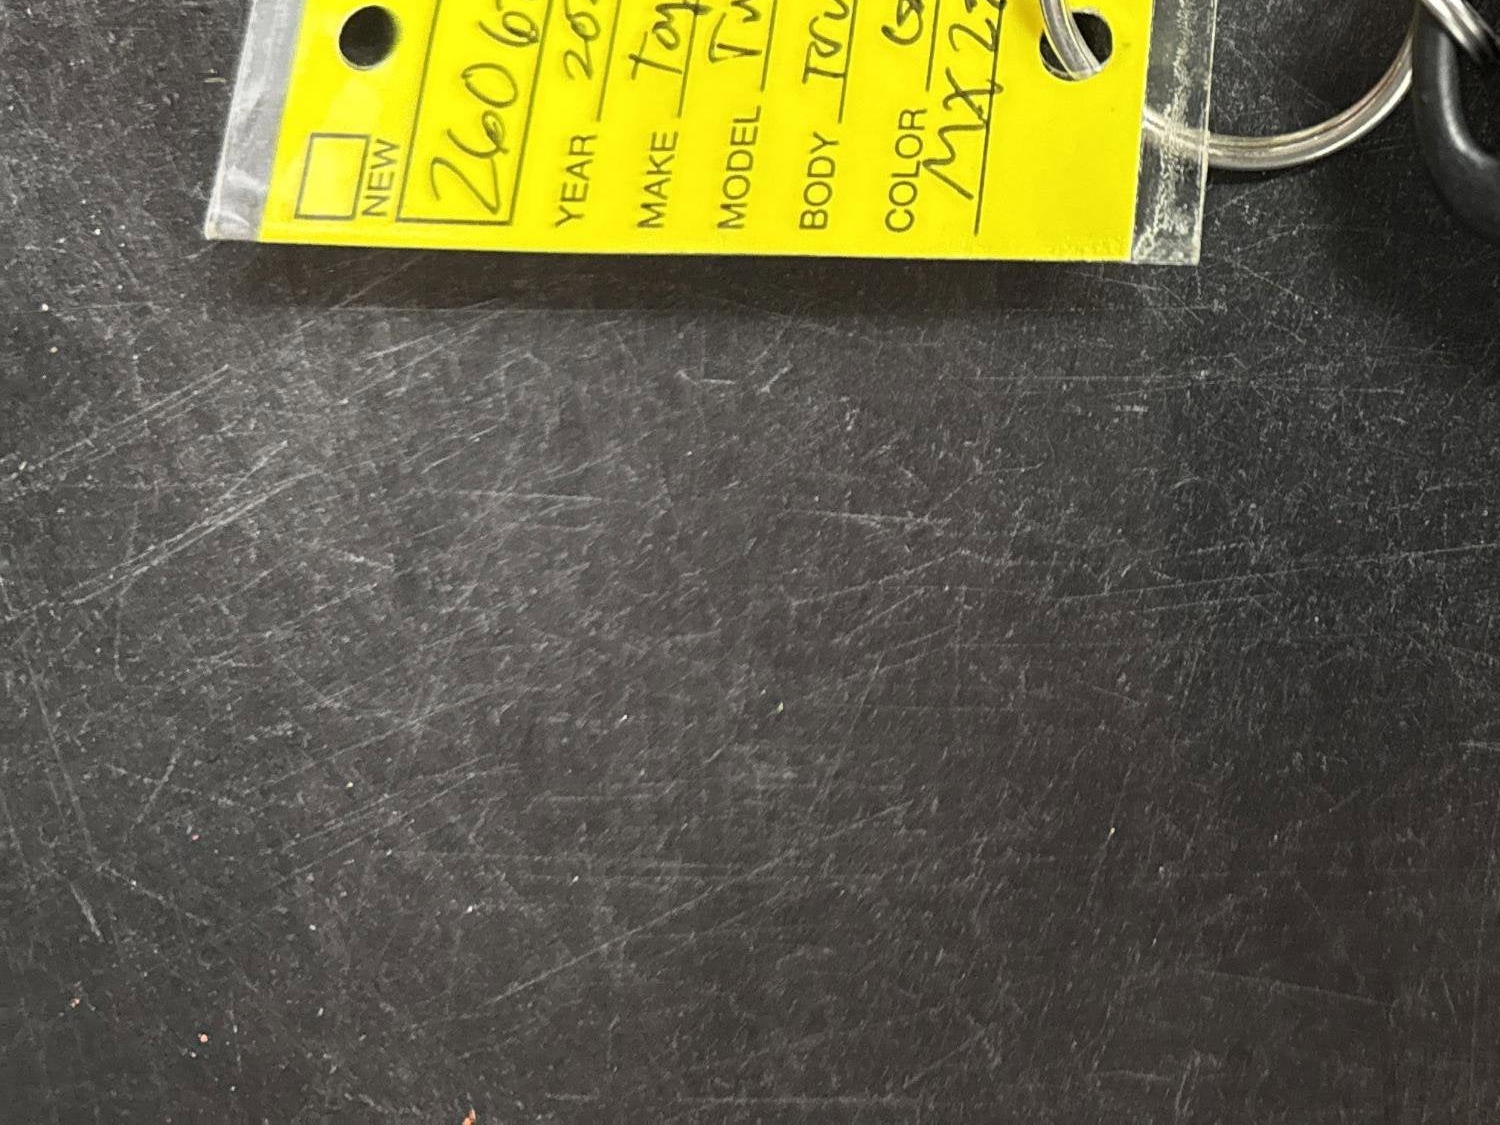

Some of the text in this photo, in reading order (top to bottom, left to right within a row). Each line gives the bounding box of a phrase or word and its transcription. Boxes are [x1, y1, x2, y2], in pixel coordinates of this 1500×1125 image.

[361, 139, 402, 218] NEW
[554, 132, 598, 228] YEAR
[636, 129, 680, 230] MAKE
[716, 105, 761, 230] MODEL
[799, 131, 841, 231] BODY
[884, 107, 928, 234] COLOR
